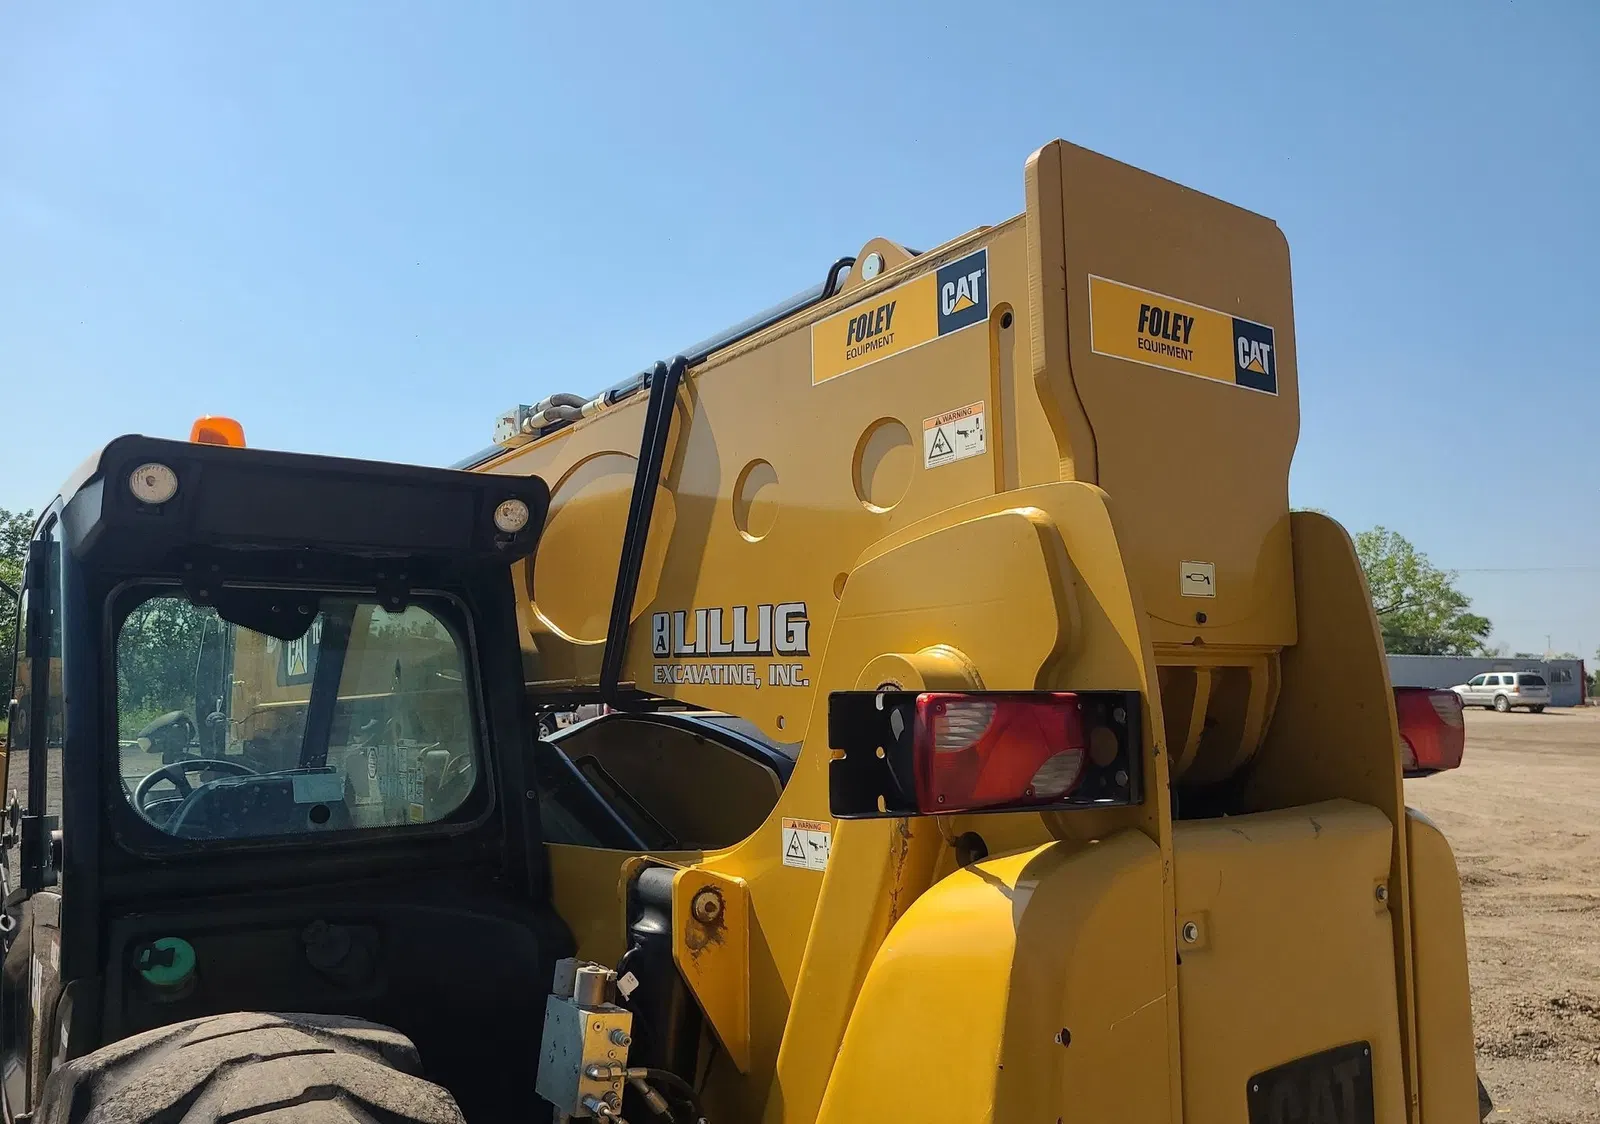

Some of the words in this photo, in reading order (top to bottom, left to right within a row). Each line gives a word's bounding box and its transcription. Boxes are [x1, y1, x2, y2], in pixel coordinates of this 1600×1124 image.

[941, 269, 981, 316] CAT
[846, 301, 897, 346] FOLEY
[1138, 304, 1194, 344] FOLEY
[846, 333, 895, 360] EQUIPMENT
[1138, 338, 1193, 361] EQUIPMENT
[1237, 336, 1270, 375] CAT
[942, 407, 972, 422] WARNING
[673, 602, 810, 657] LILLIG
[653, 664, 761, 689] EXCAVATING,
[769, 664, 809, 687] INC.
[798, 822, 821, 830] WARNING
